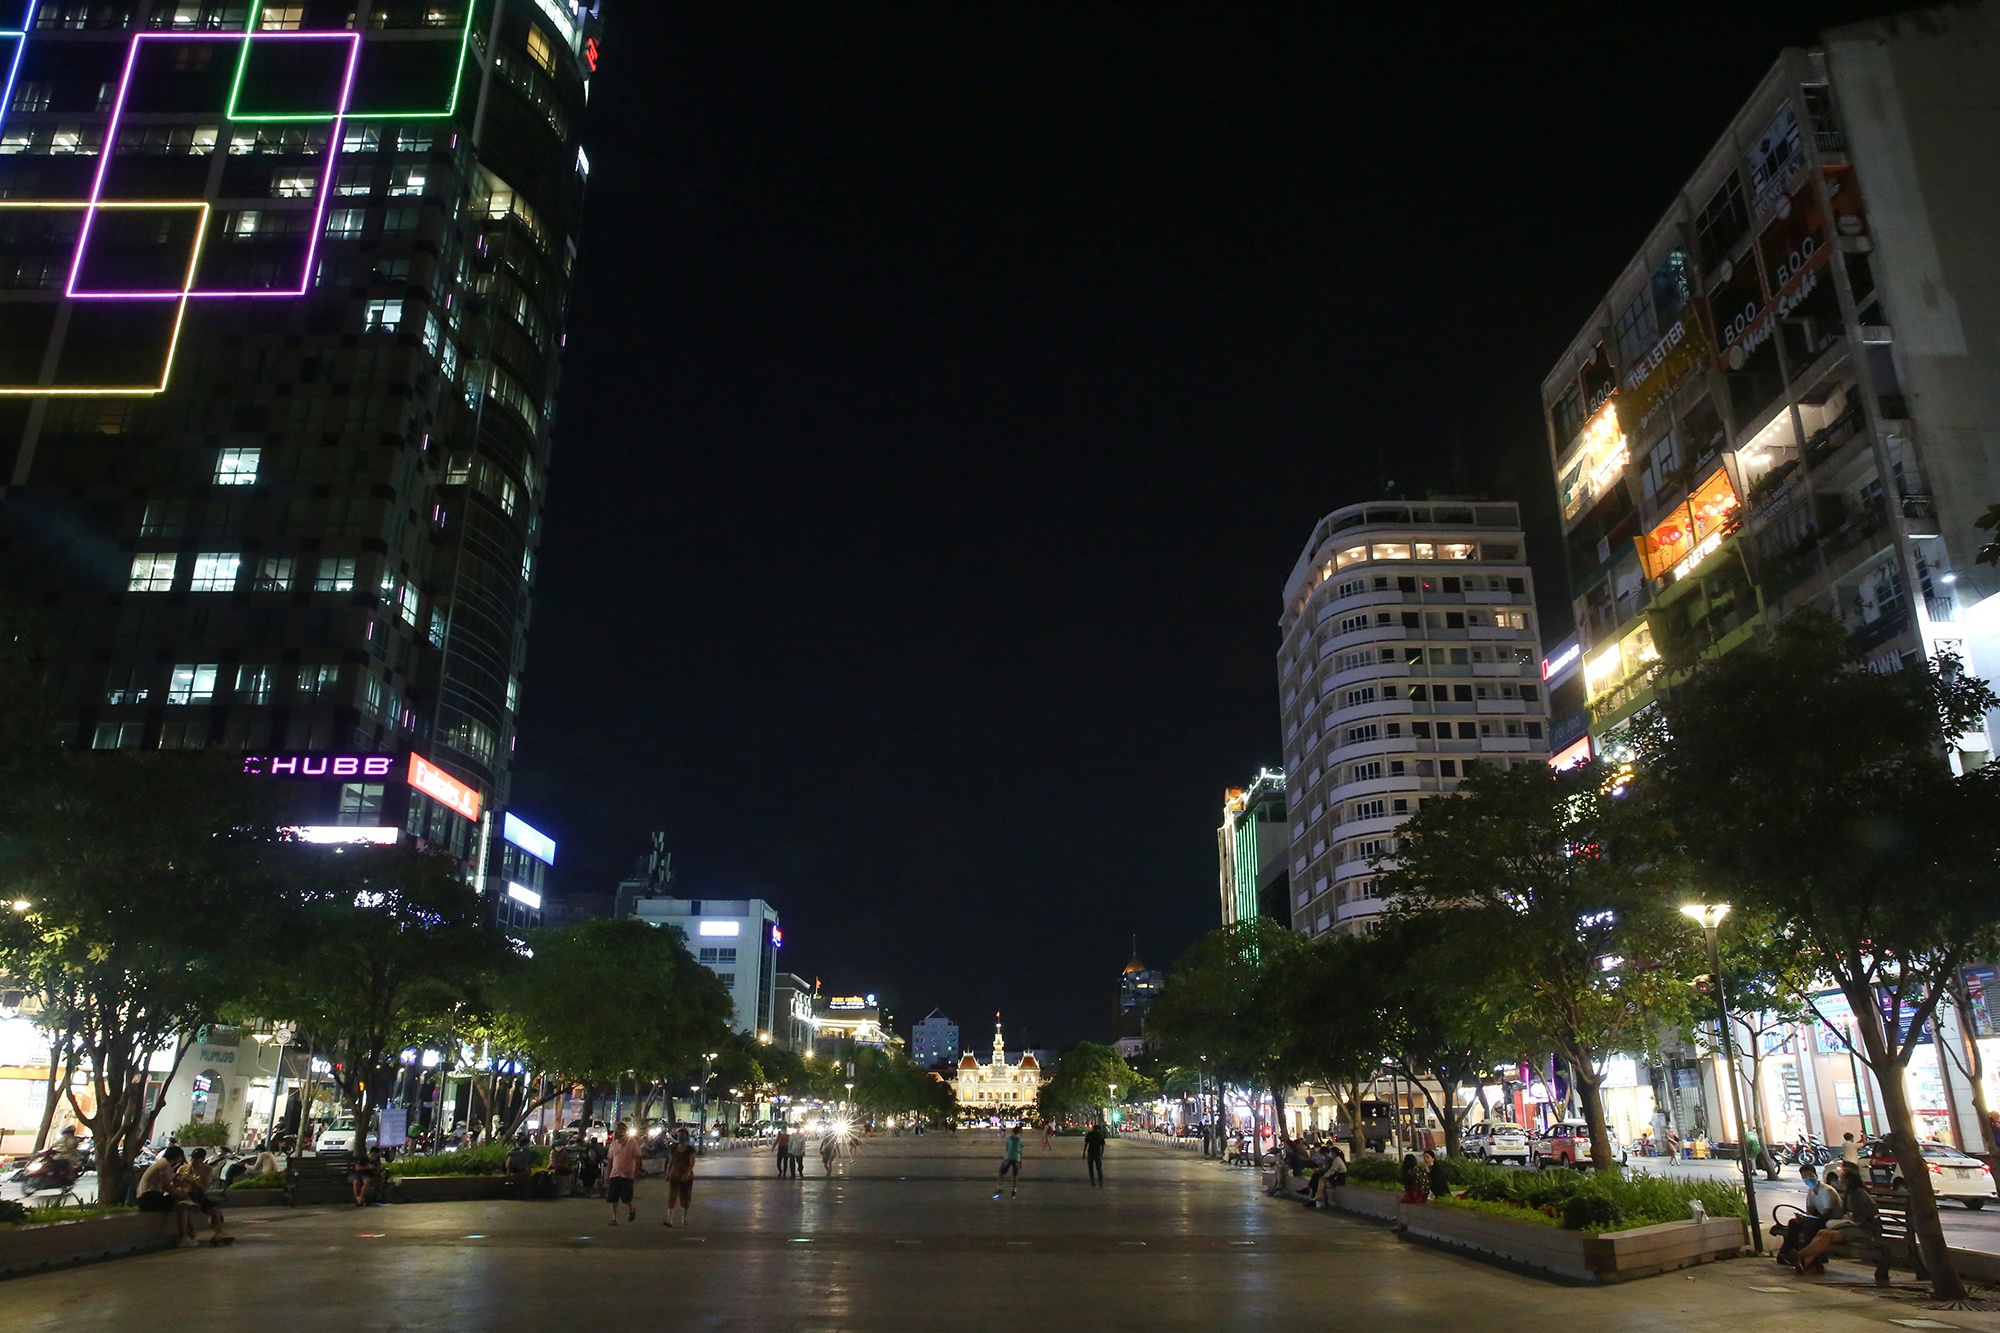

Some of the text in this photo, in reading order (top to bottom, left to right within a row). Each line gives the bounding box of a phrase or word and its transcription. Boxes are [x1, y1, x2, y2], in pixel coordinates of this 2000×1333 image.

[1777, 236, 1815, 288] BOO
[1777, 268, 1818, 320] Sushi
[1724, 301, 1756, 346] BOO
[1628, 320, 1686, 391] THE LETTER
[1589, 380, 1612, 414] BOO
[1673, 531, 1723, 582] THE LETTER
[415, 760, 460, 808] Emirates
